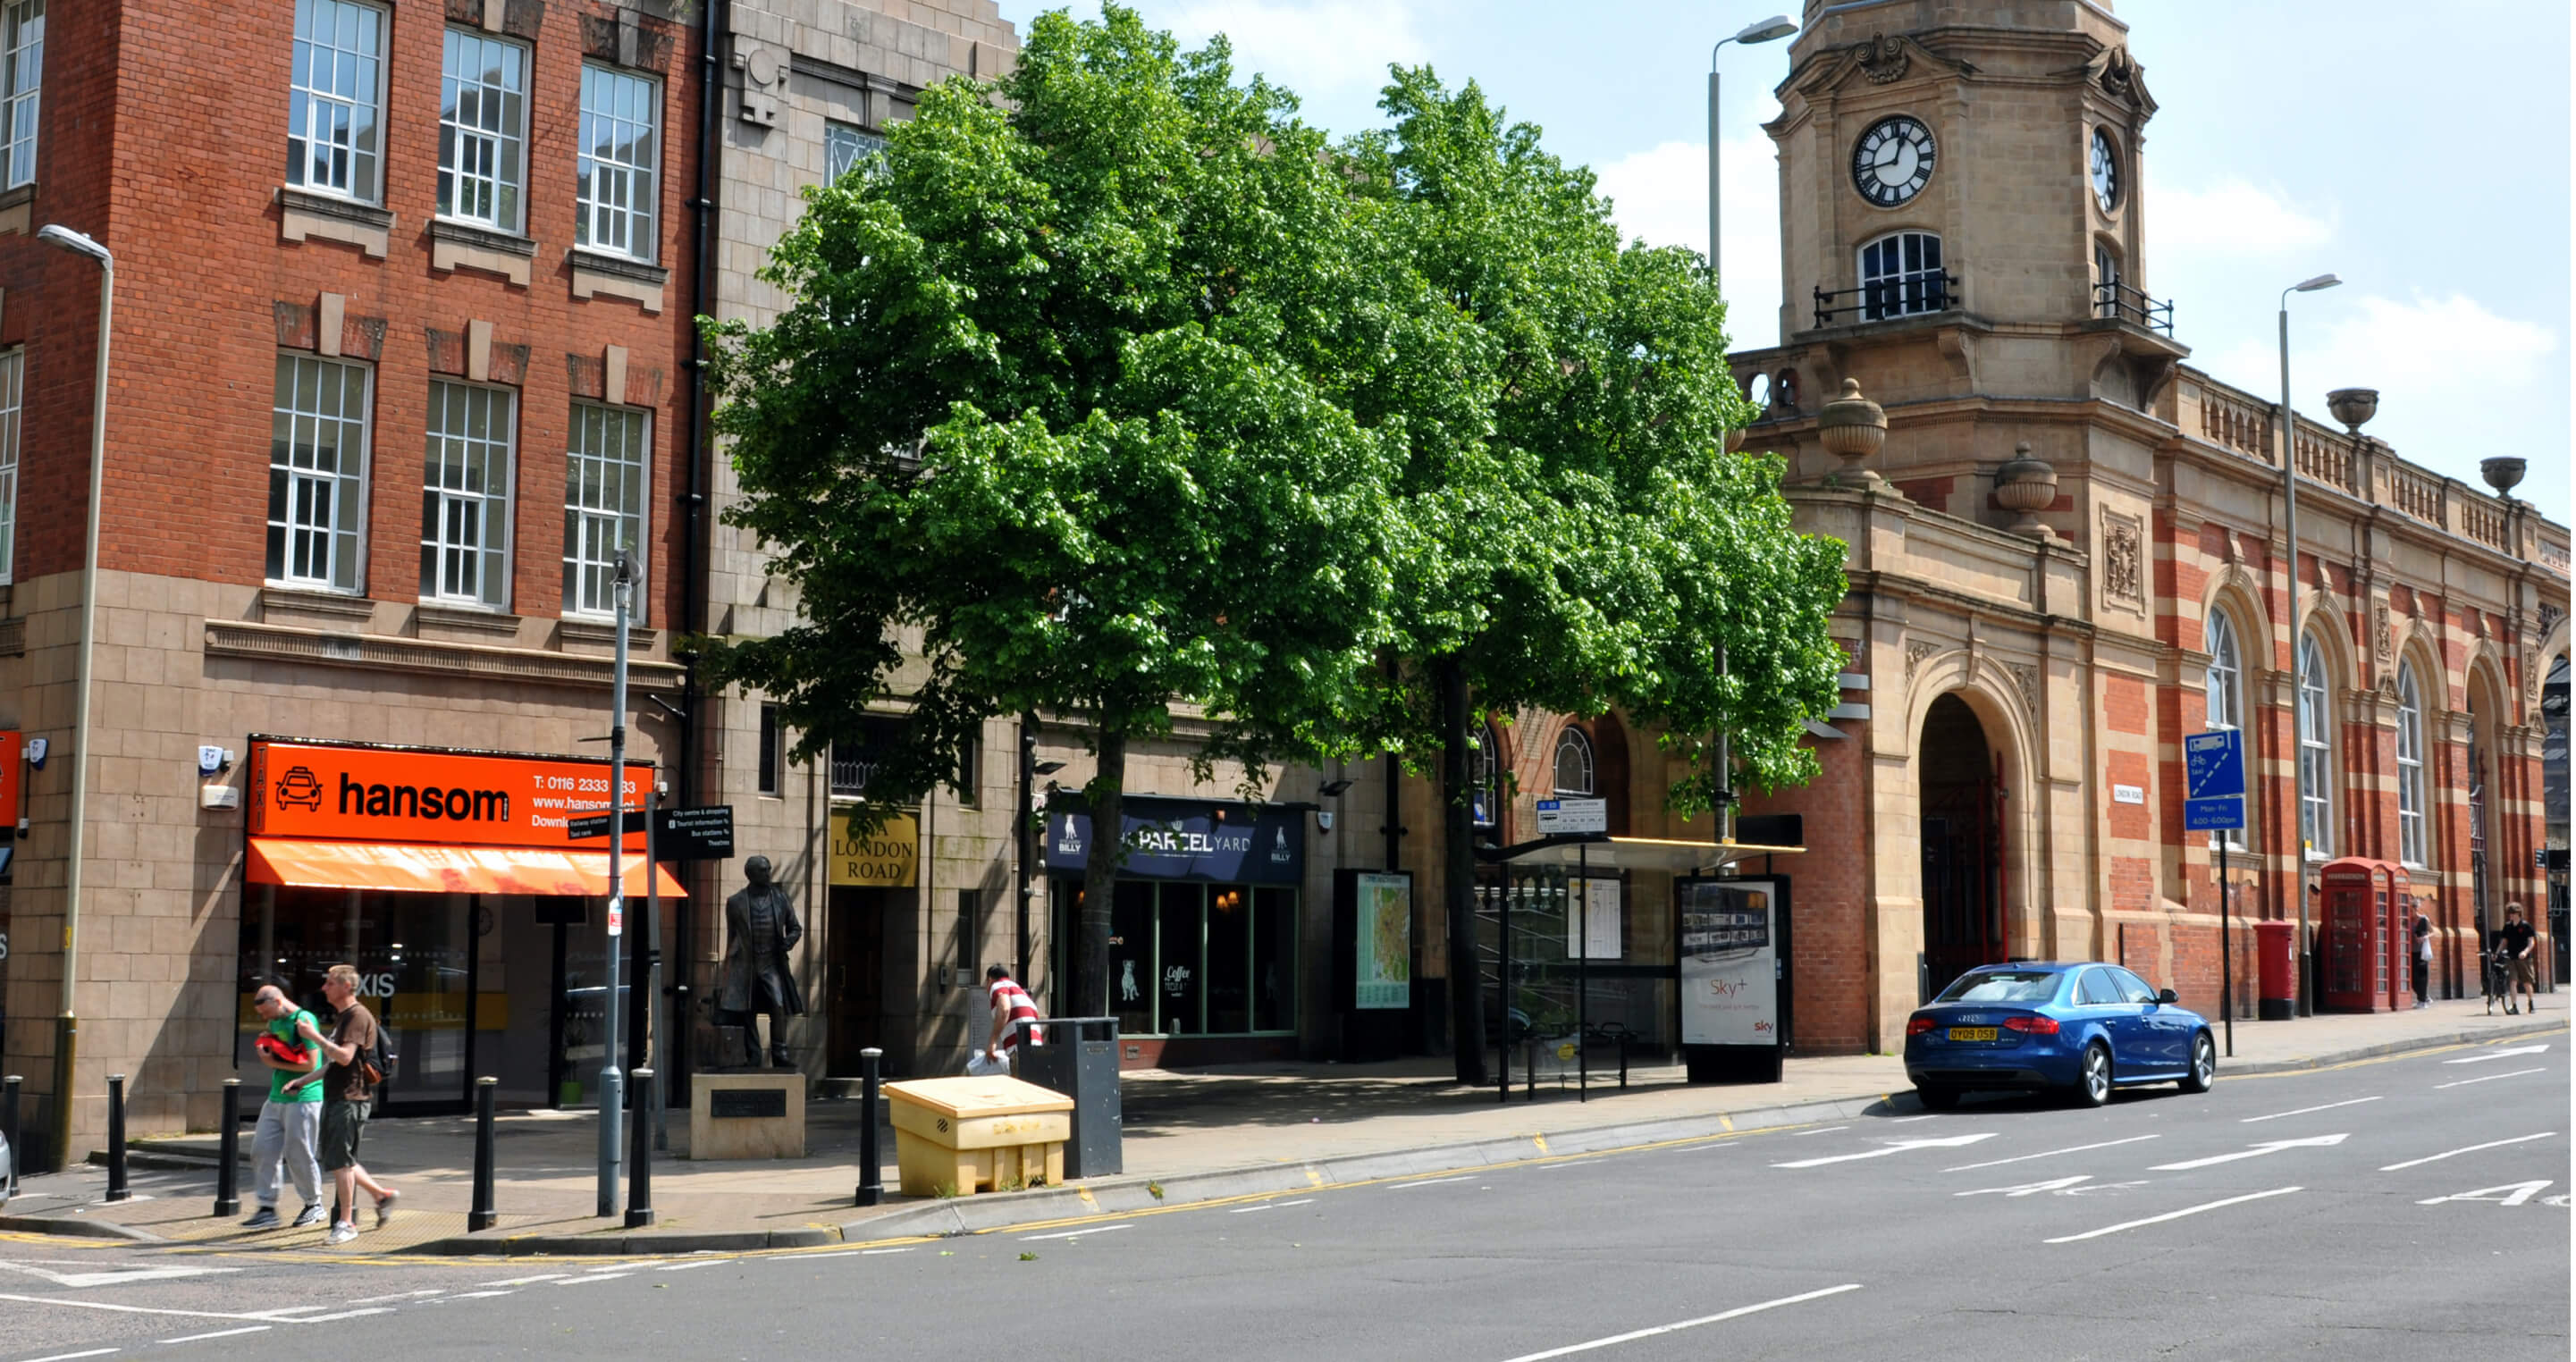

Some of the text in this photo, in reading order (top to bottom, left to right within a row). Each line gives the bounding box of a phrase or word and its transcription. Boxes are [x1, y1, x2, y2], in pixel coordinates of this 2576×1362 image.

[256, 745, 267, 829] TAXI
[534, 776, 544, 788] T:
[548, 777, 575, 791] 0116
[578, 778, 609, 793] 2333
[340, 772, 509, 821] hansom
[695, 818, 722, 826] information
[835, 838, 913, 859] LONDON
[1058, 843, 1082, 853] BILLY
[1215, 836, 1251, 852] YARD
[1271, 853, 1291, 862] BILLY
[847, 862, 902, 879] ROAD
[1166, 965, 1191, 982] Coffee
[1755, 1020, 1774, 1034] sky
